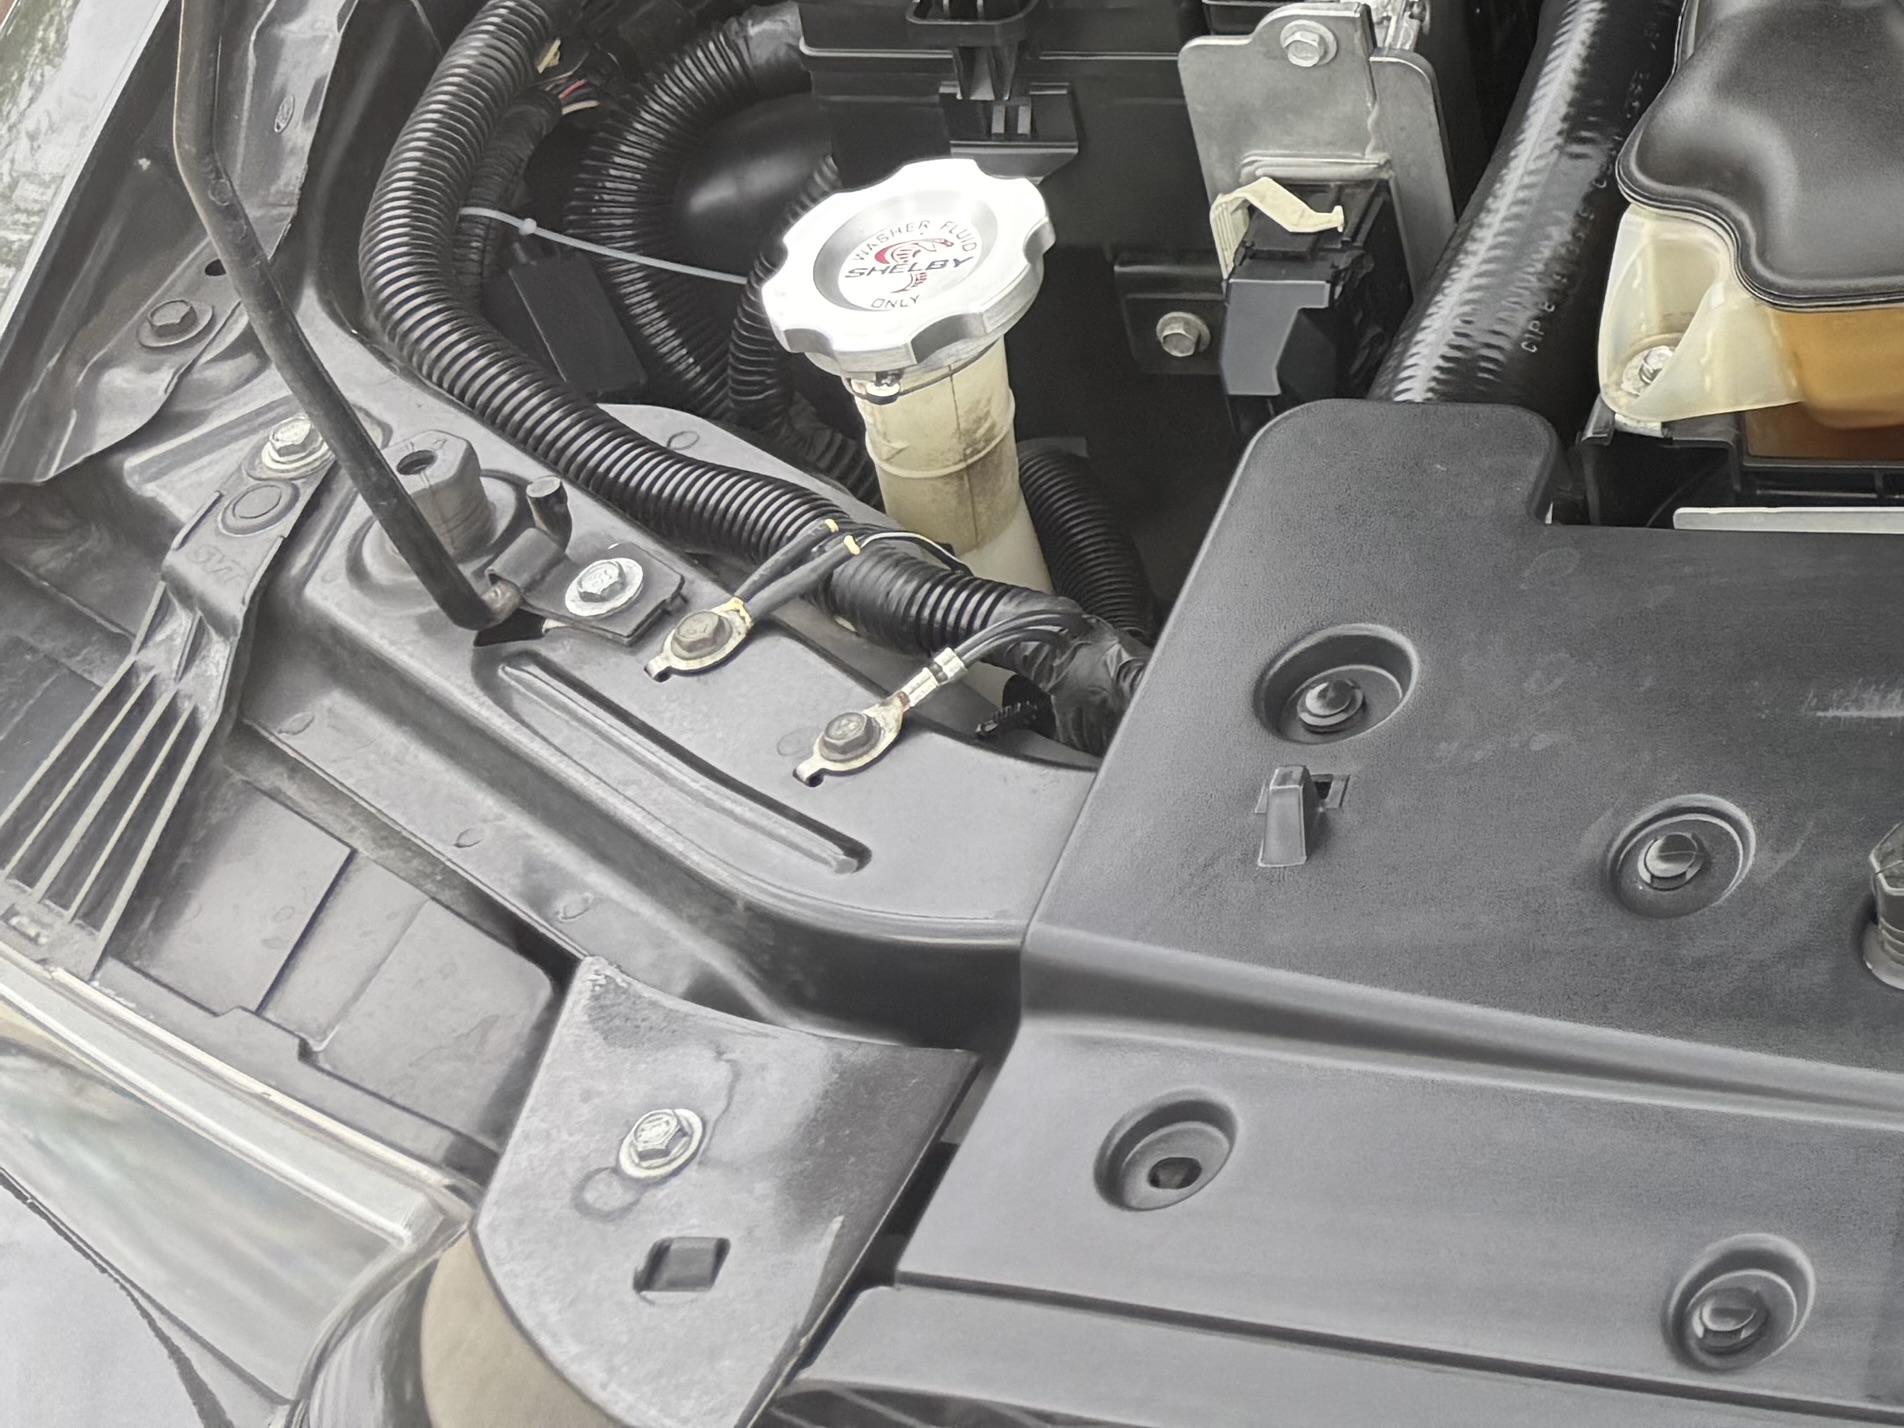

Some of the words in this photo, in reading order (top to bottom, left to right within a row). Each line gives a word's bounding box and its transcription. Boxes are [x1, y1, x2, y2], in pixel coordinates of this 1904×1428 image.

[852, 219, 930, 262] WASHER
[940, 220, 978, 253] FLUID
[845, 256, 973, 278] SHELBY
[870, 294, 922, 309] ONLY
